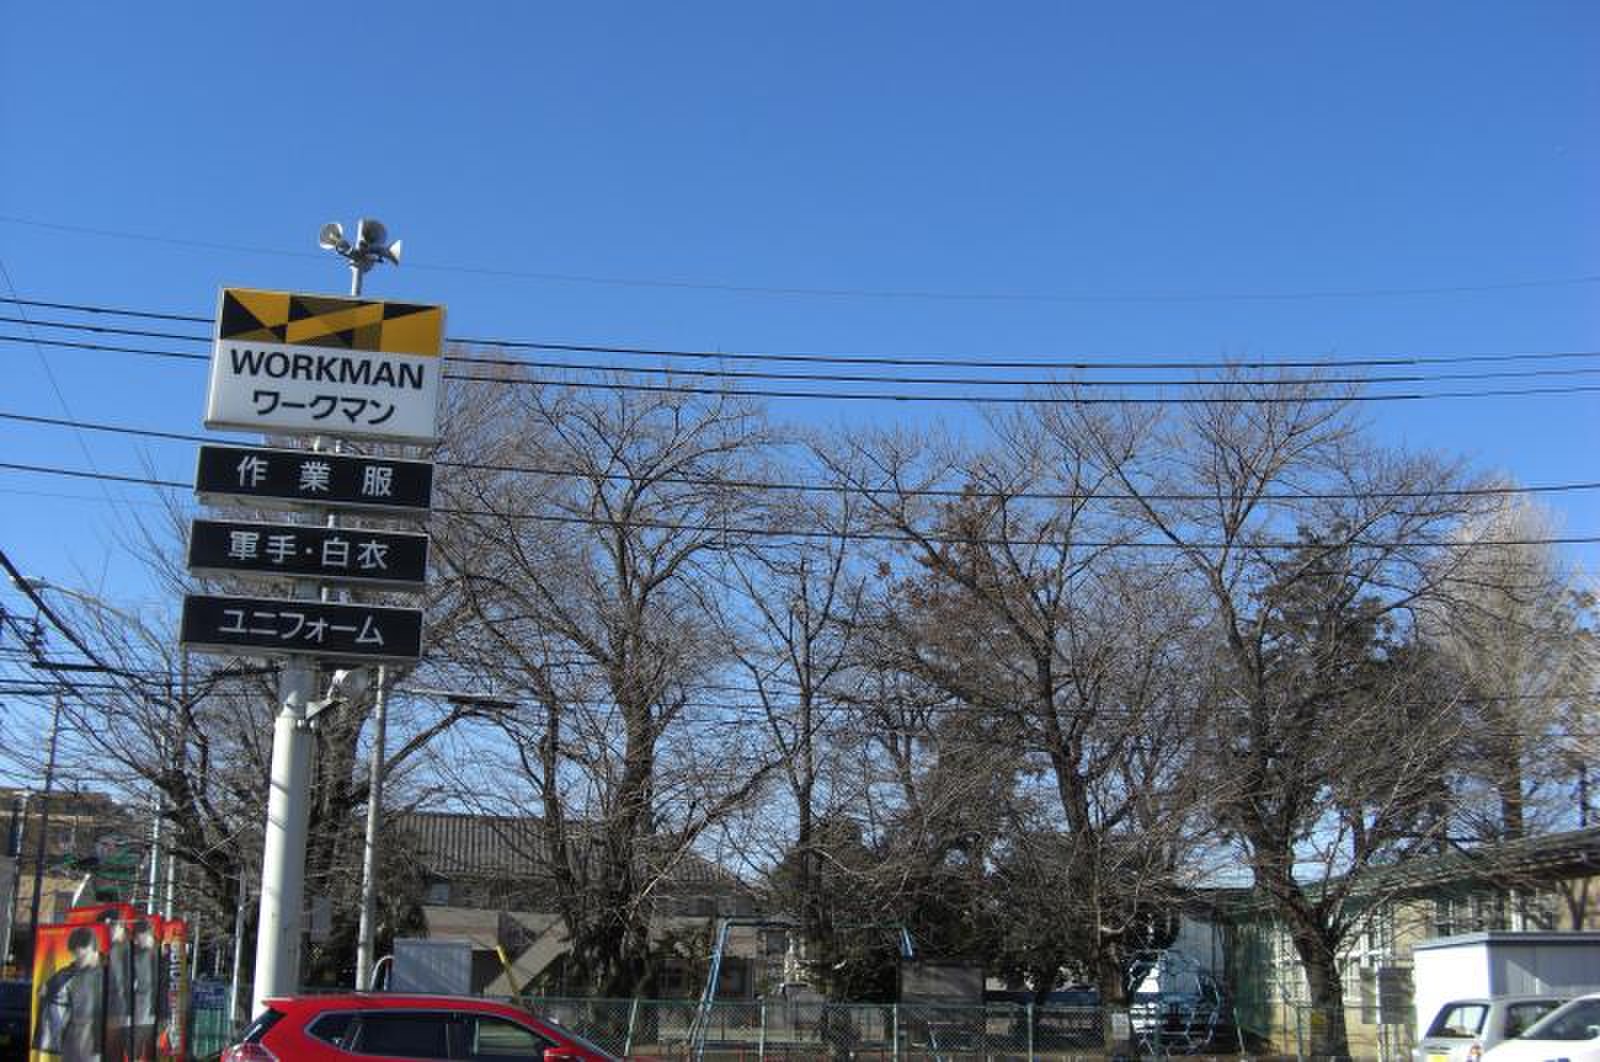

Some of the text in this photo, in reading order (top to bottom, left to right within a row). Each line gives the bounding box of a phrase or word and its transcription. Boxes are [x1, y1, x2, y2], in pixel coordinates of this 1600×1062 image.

[230, 349, 424, 390] WORKMAN
[252, 390, 395, 425] ワークマン
[237, 456, 393, 497] 作業服
[219, 608, 385, 647] ユニフォーム
